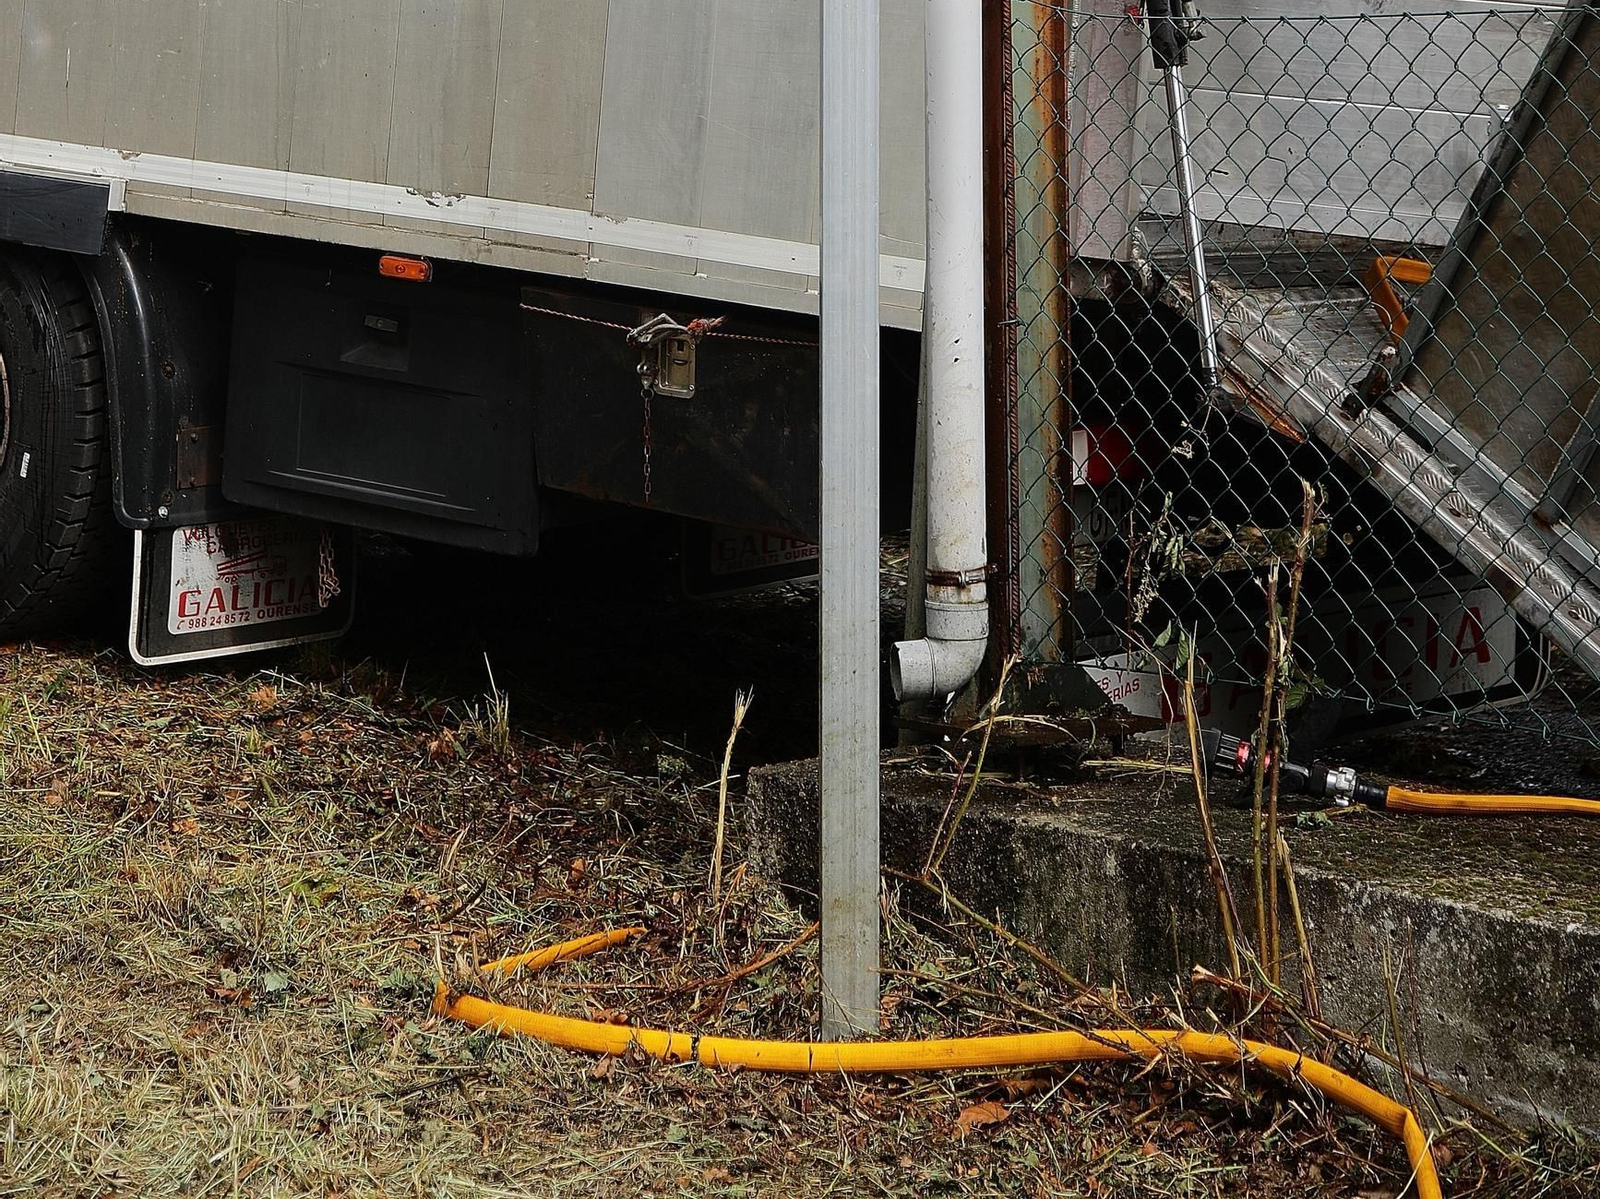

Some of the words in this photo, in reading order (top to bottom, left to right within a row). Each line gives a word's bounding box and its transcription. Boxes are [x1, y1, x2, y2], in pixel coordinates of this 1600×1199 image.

[178, 574, 318, 618] GALICIA
[187, 617, 207, 630] 988
[209, 615, 222, 627] 24
[224, 613, 237, 625] 85
[238, 611, 251, 623] 72
[256, 601, 318, 620] OURENSE
